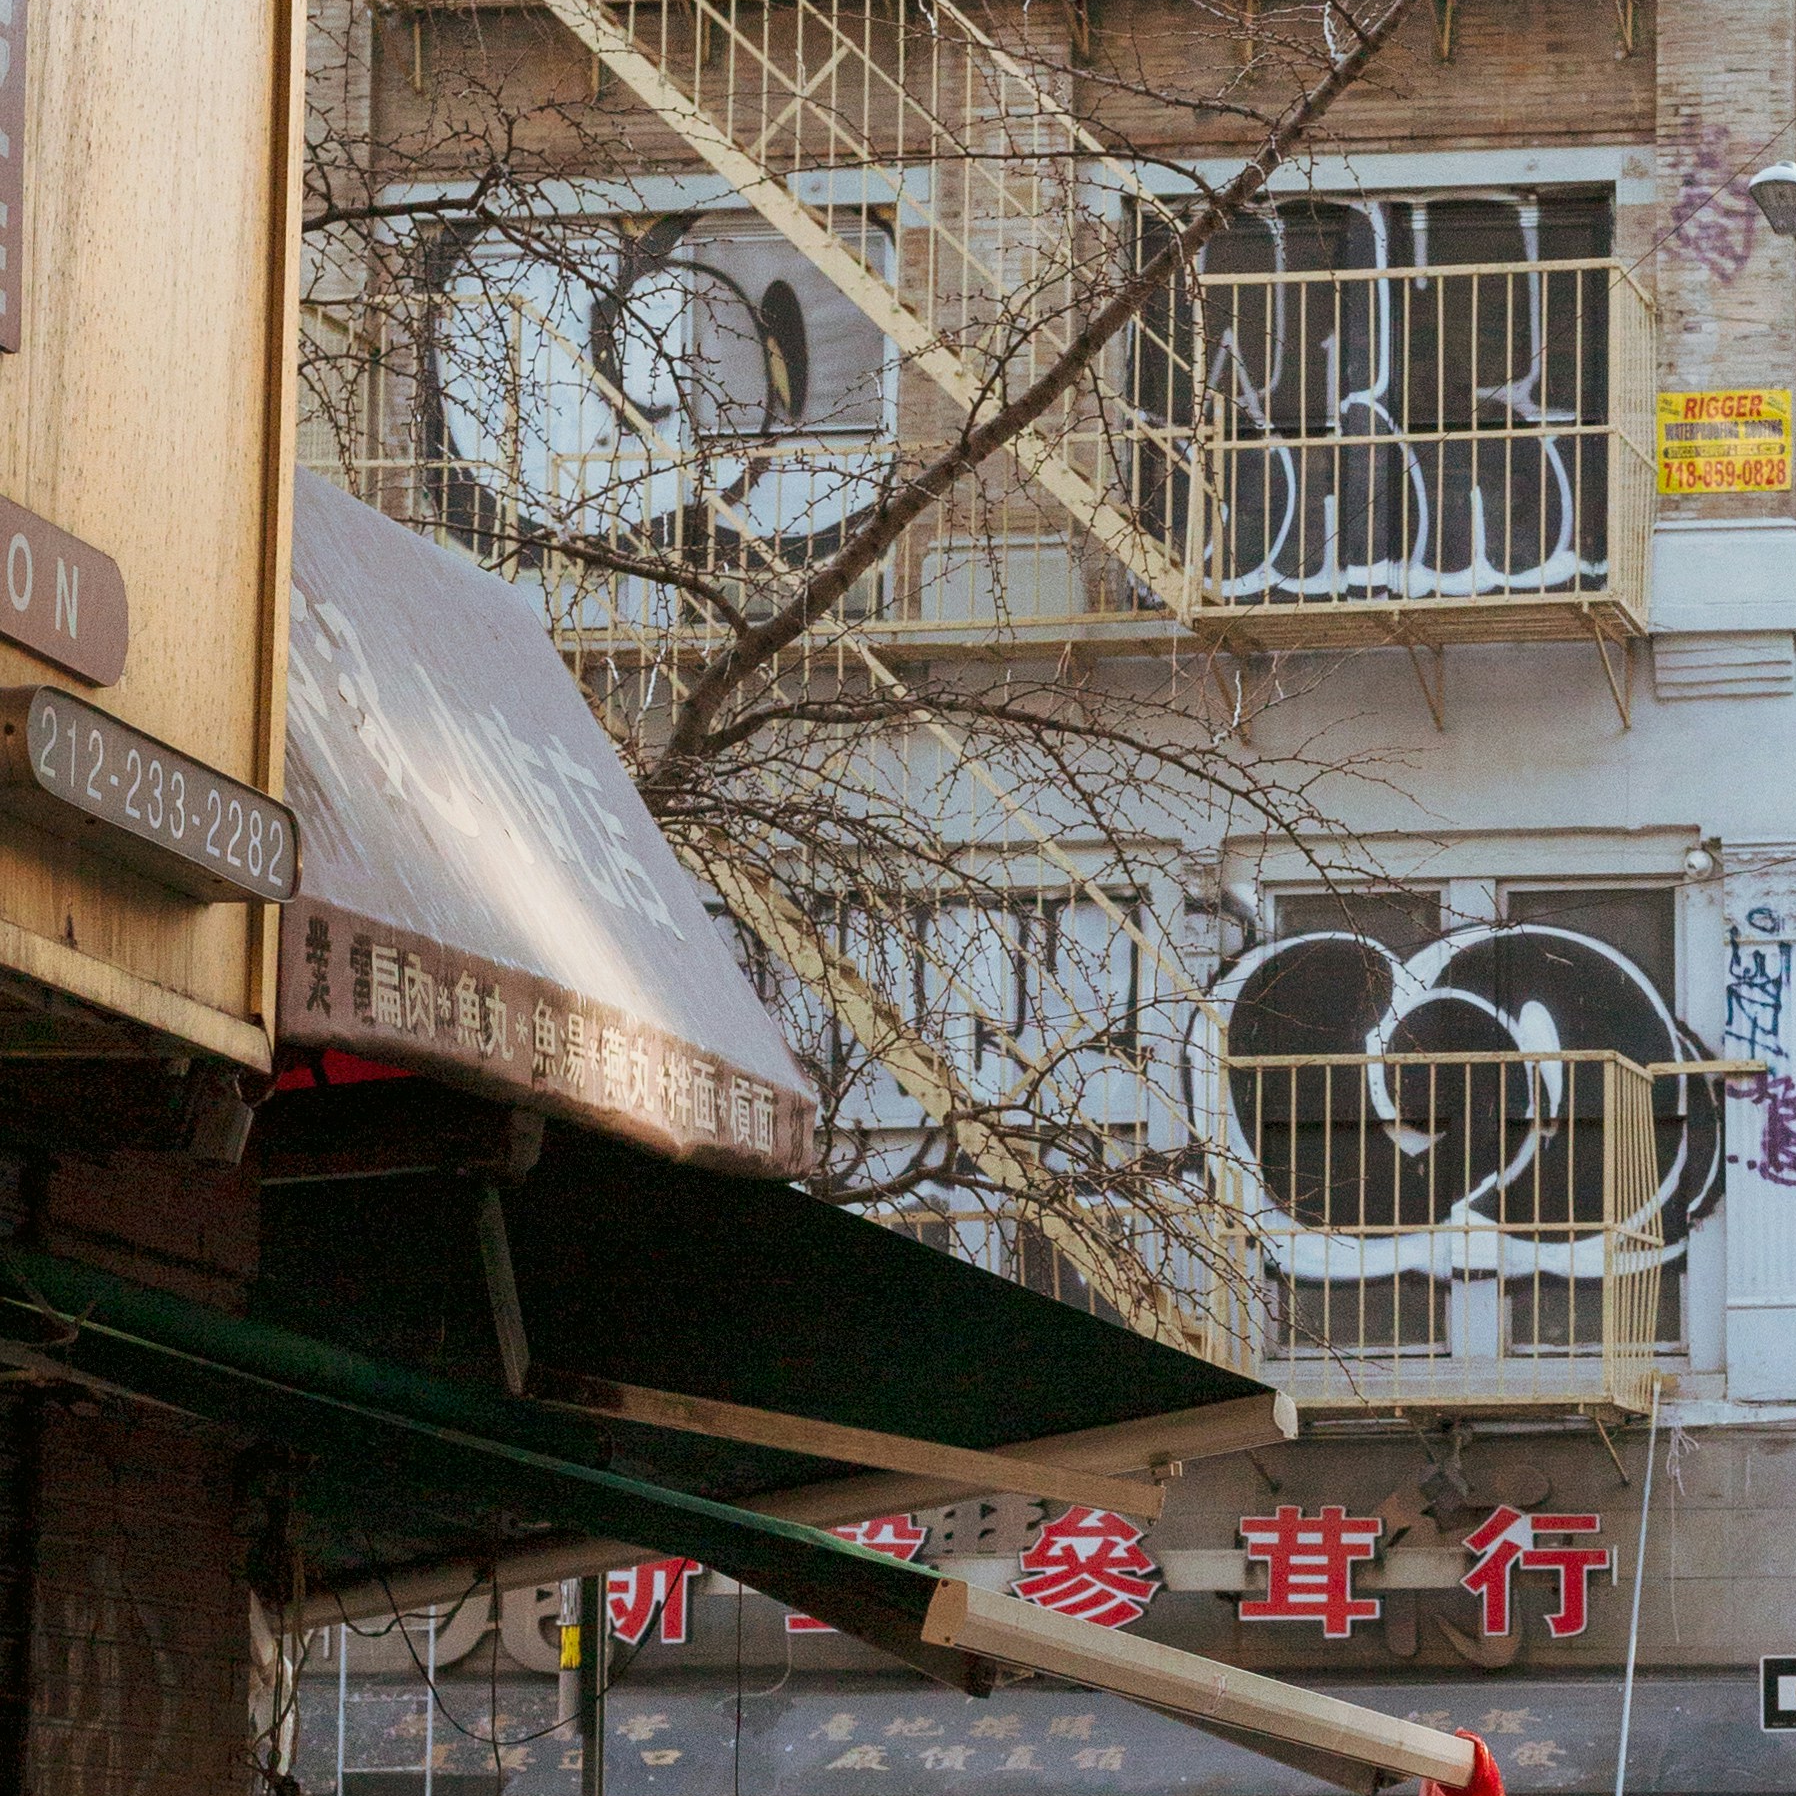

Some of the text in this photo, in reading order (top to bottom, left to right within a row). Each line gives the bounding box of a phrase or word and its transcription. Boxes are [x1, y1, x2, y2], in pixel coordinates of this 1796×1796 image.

[1684, 395, 1763, 420] RIGGER
[1663, 458, 1786, 489] 718-859-0828
[38, 705, 286, 889] 212-233-2282
